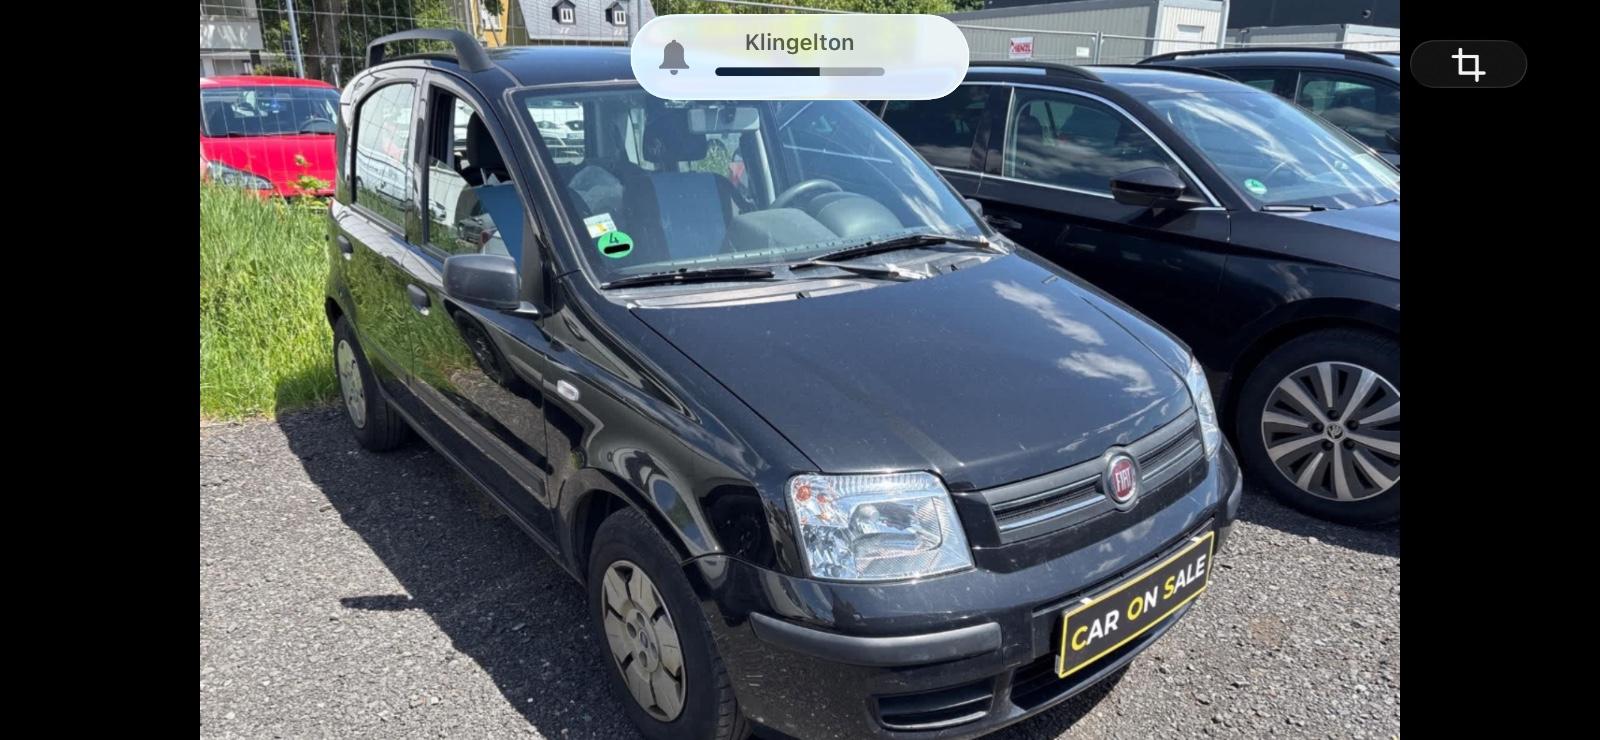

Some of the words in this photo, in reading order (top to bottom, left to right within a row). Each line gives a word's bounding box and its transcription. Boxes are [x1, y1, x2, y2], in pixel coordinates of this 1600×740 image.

[1115, 467, 1131, 493] FIAT
[1071, 609, 1119, 651] CAR
[1127, 586, 1158, 621] ON
[1163, 554, 1206, 599] SALE
